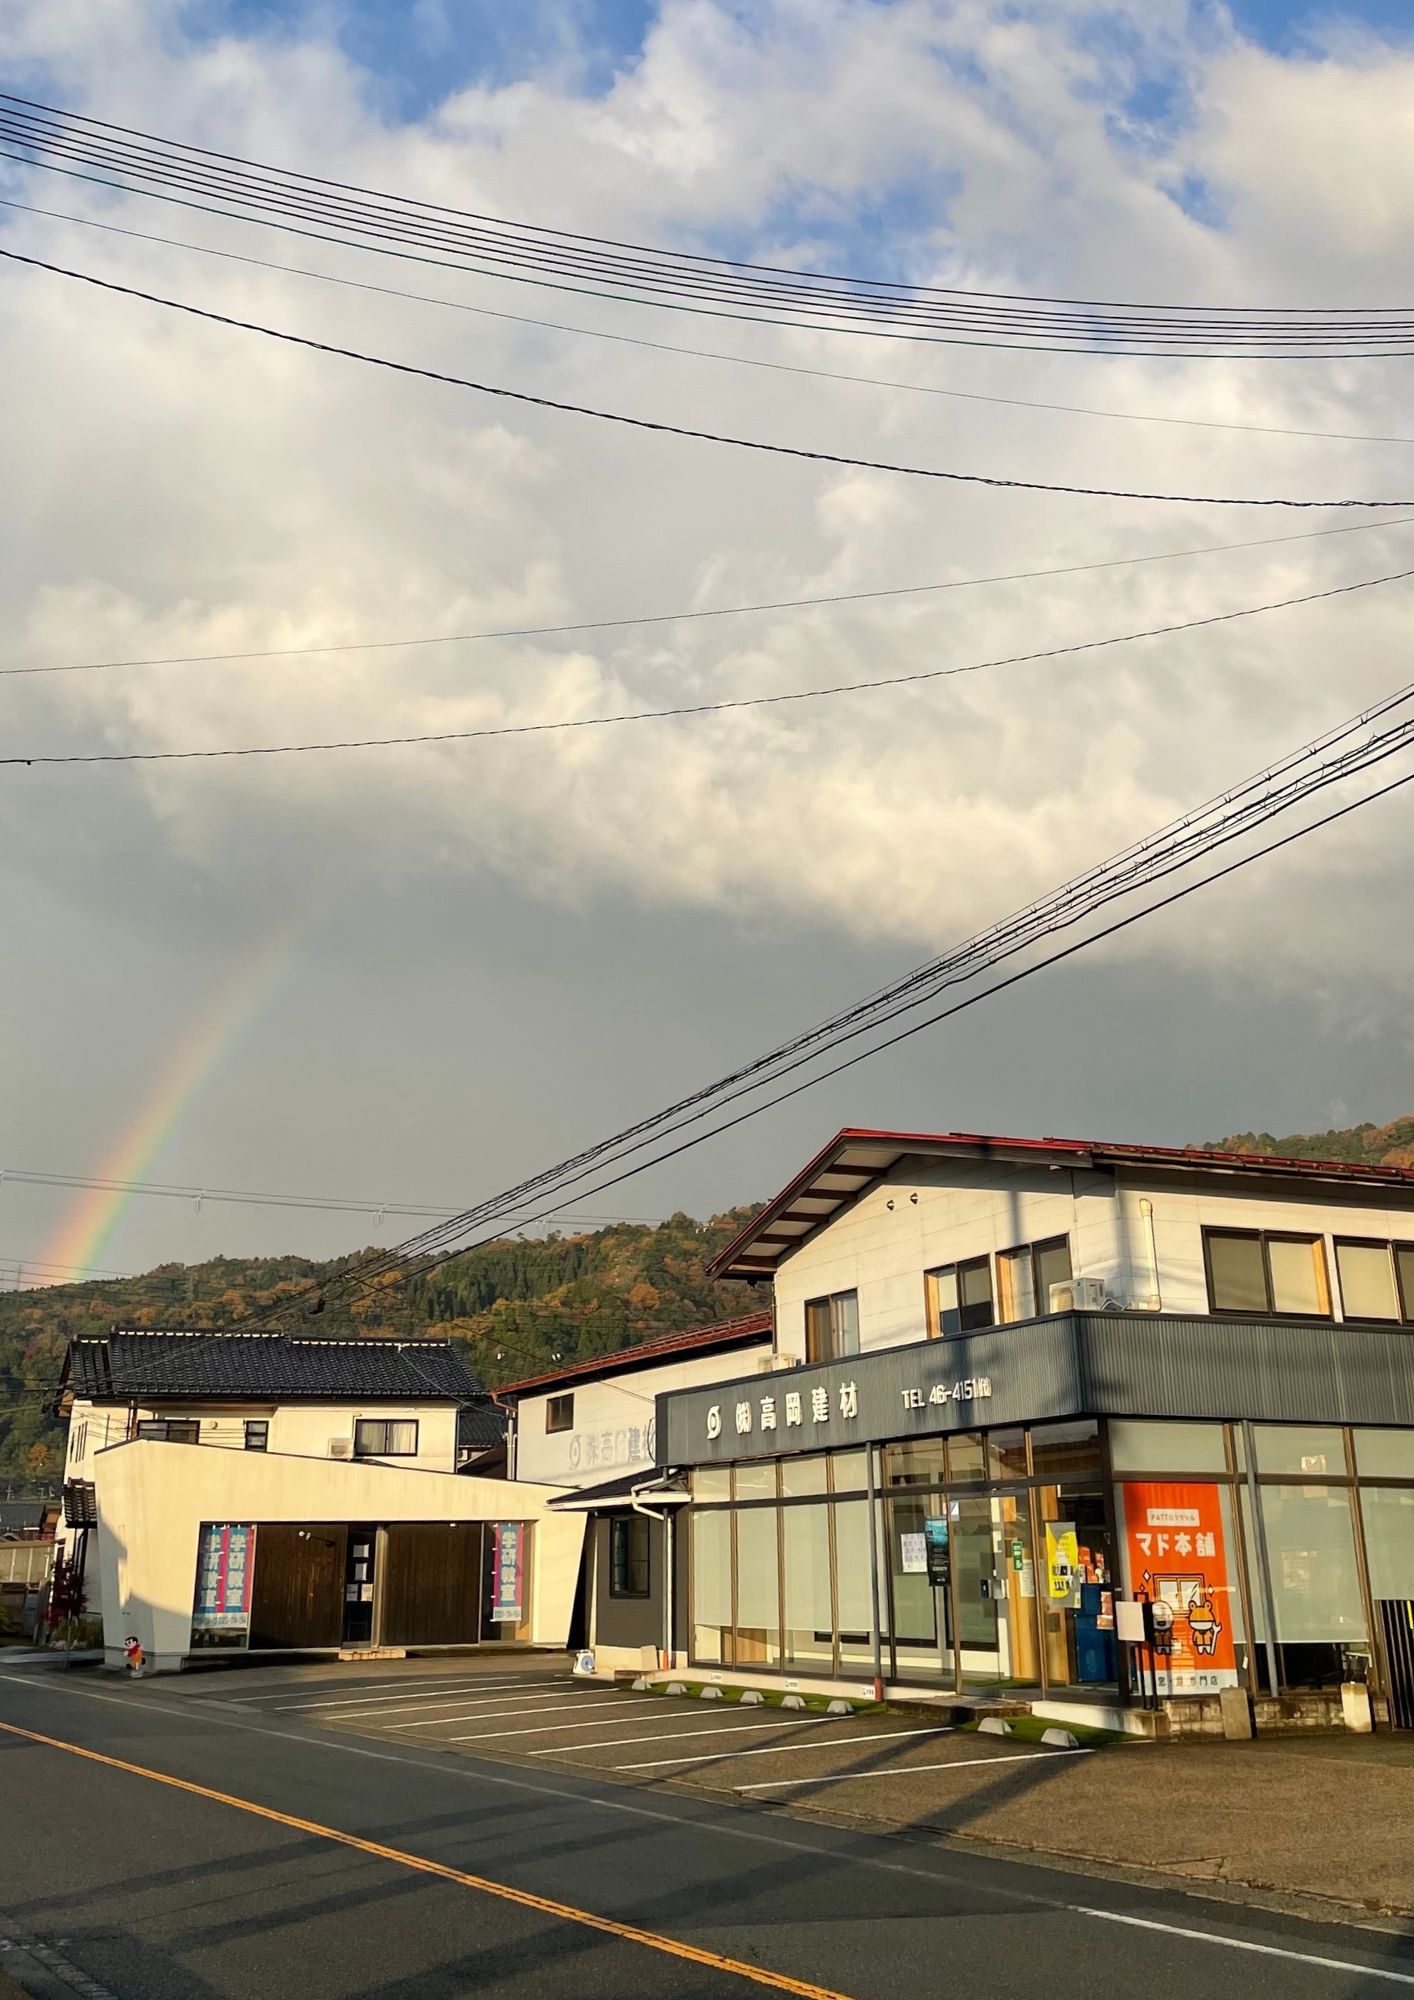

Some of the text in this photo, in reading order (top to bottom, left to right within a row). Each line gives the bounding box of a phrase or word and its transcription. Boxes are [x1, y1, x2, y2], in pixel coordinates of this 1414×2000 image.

[902, 1388, 925, 1409] TEL
[1135, 1532, 1215, 1557] マド本舗
[500, 1531, 517, 1601] 学研教室
